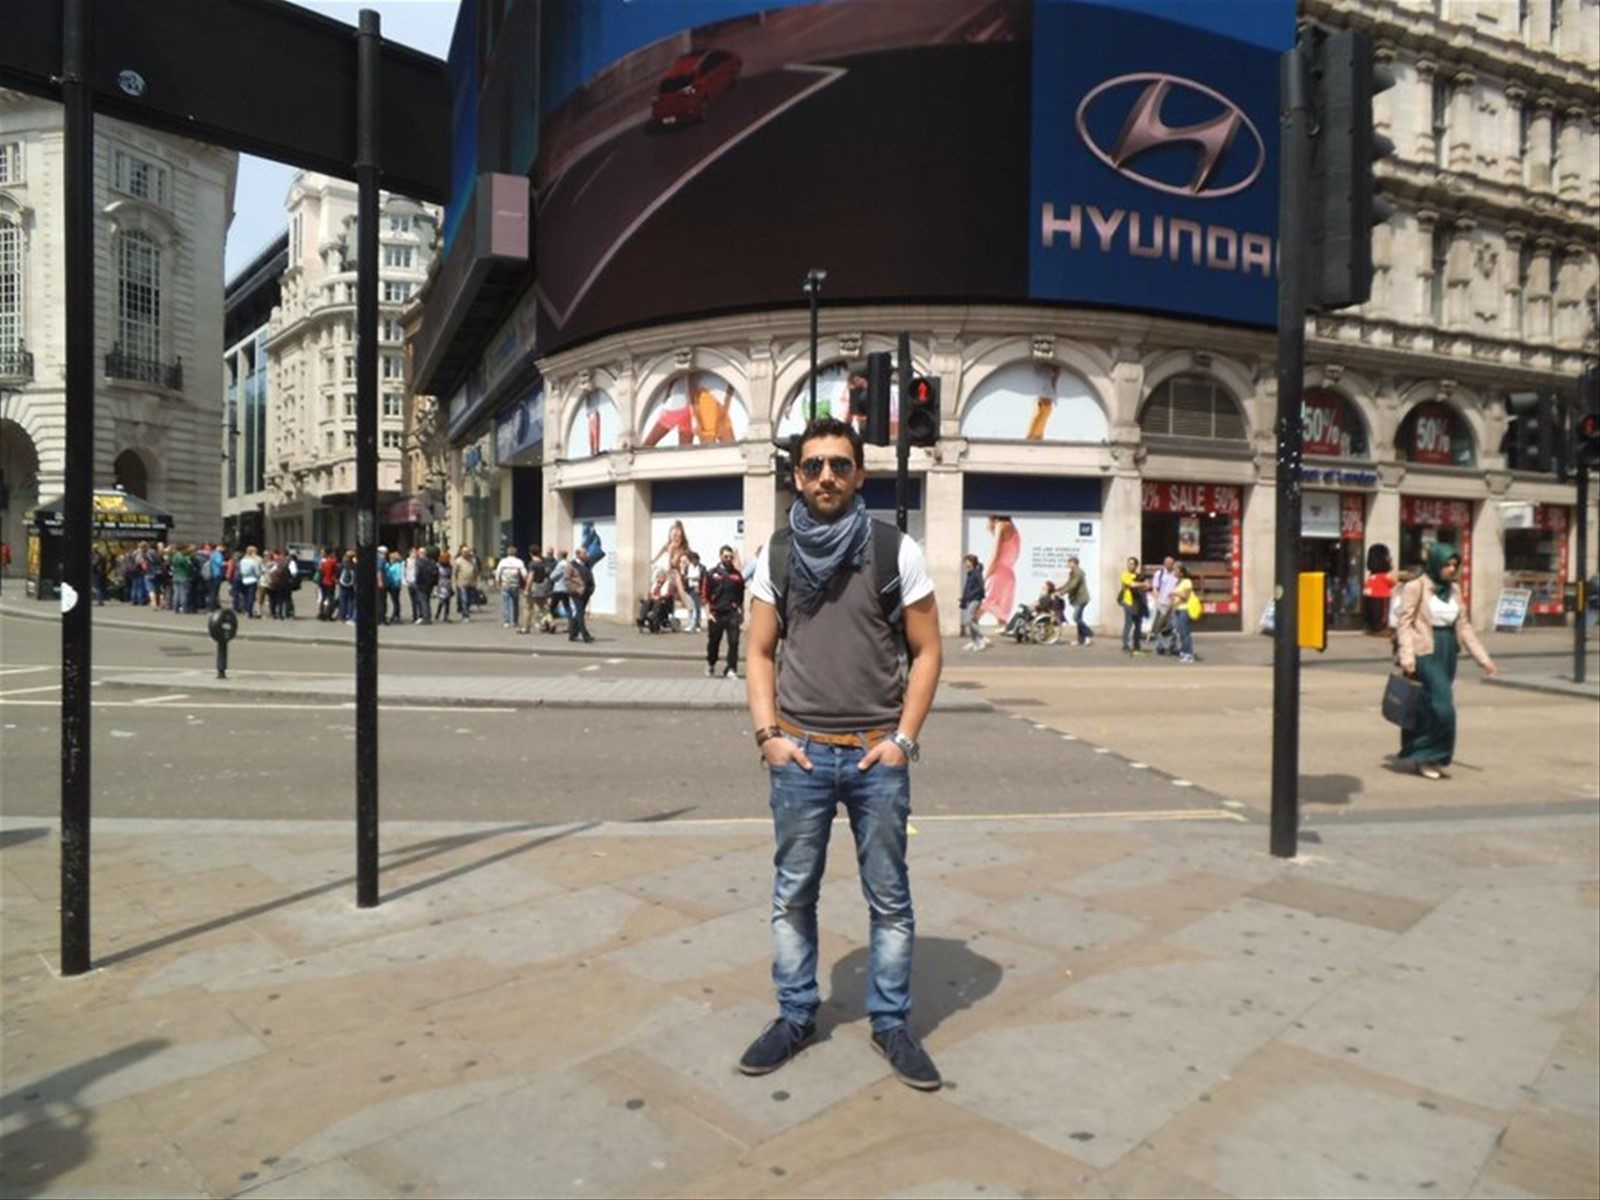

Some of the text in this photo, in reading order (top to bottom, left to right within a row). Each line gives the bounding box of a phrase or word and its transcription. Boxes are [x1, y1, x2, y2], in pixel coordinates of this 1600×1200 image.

[1302, 408, 1340, 445] 50%
[1417, 417, 1450, 453] 50%
[1170, 484, 1206, 512] SALE
[1214, 486, 1240, 513] 50%
